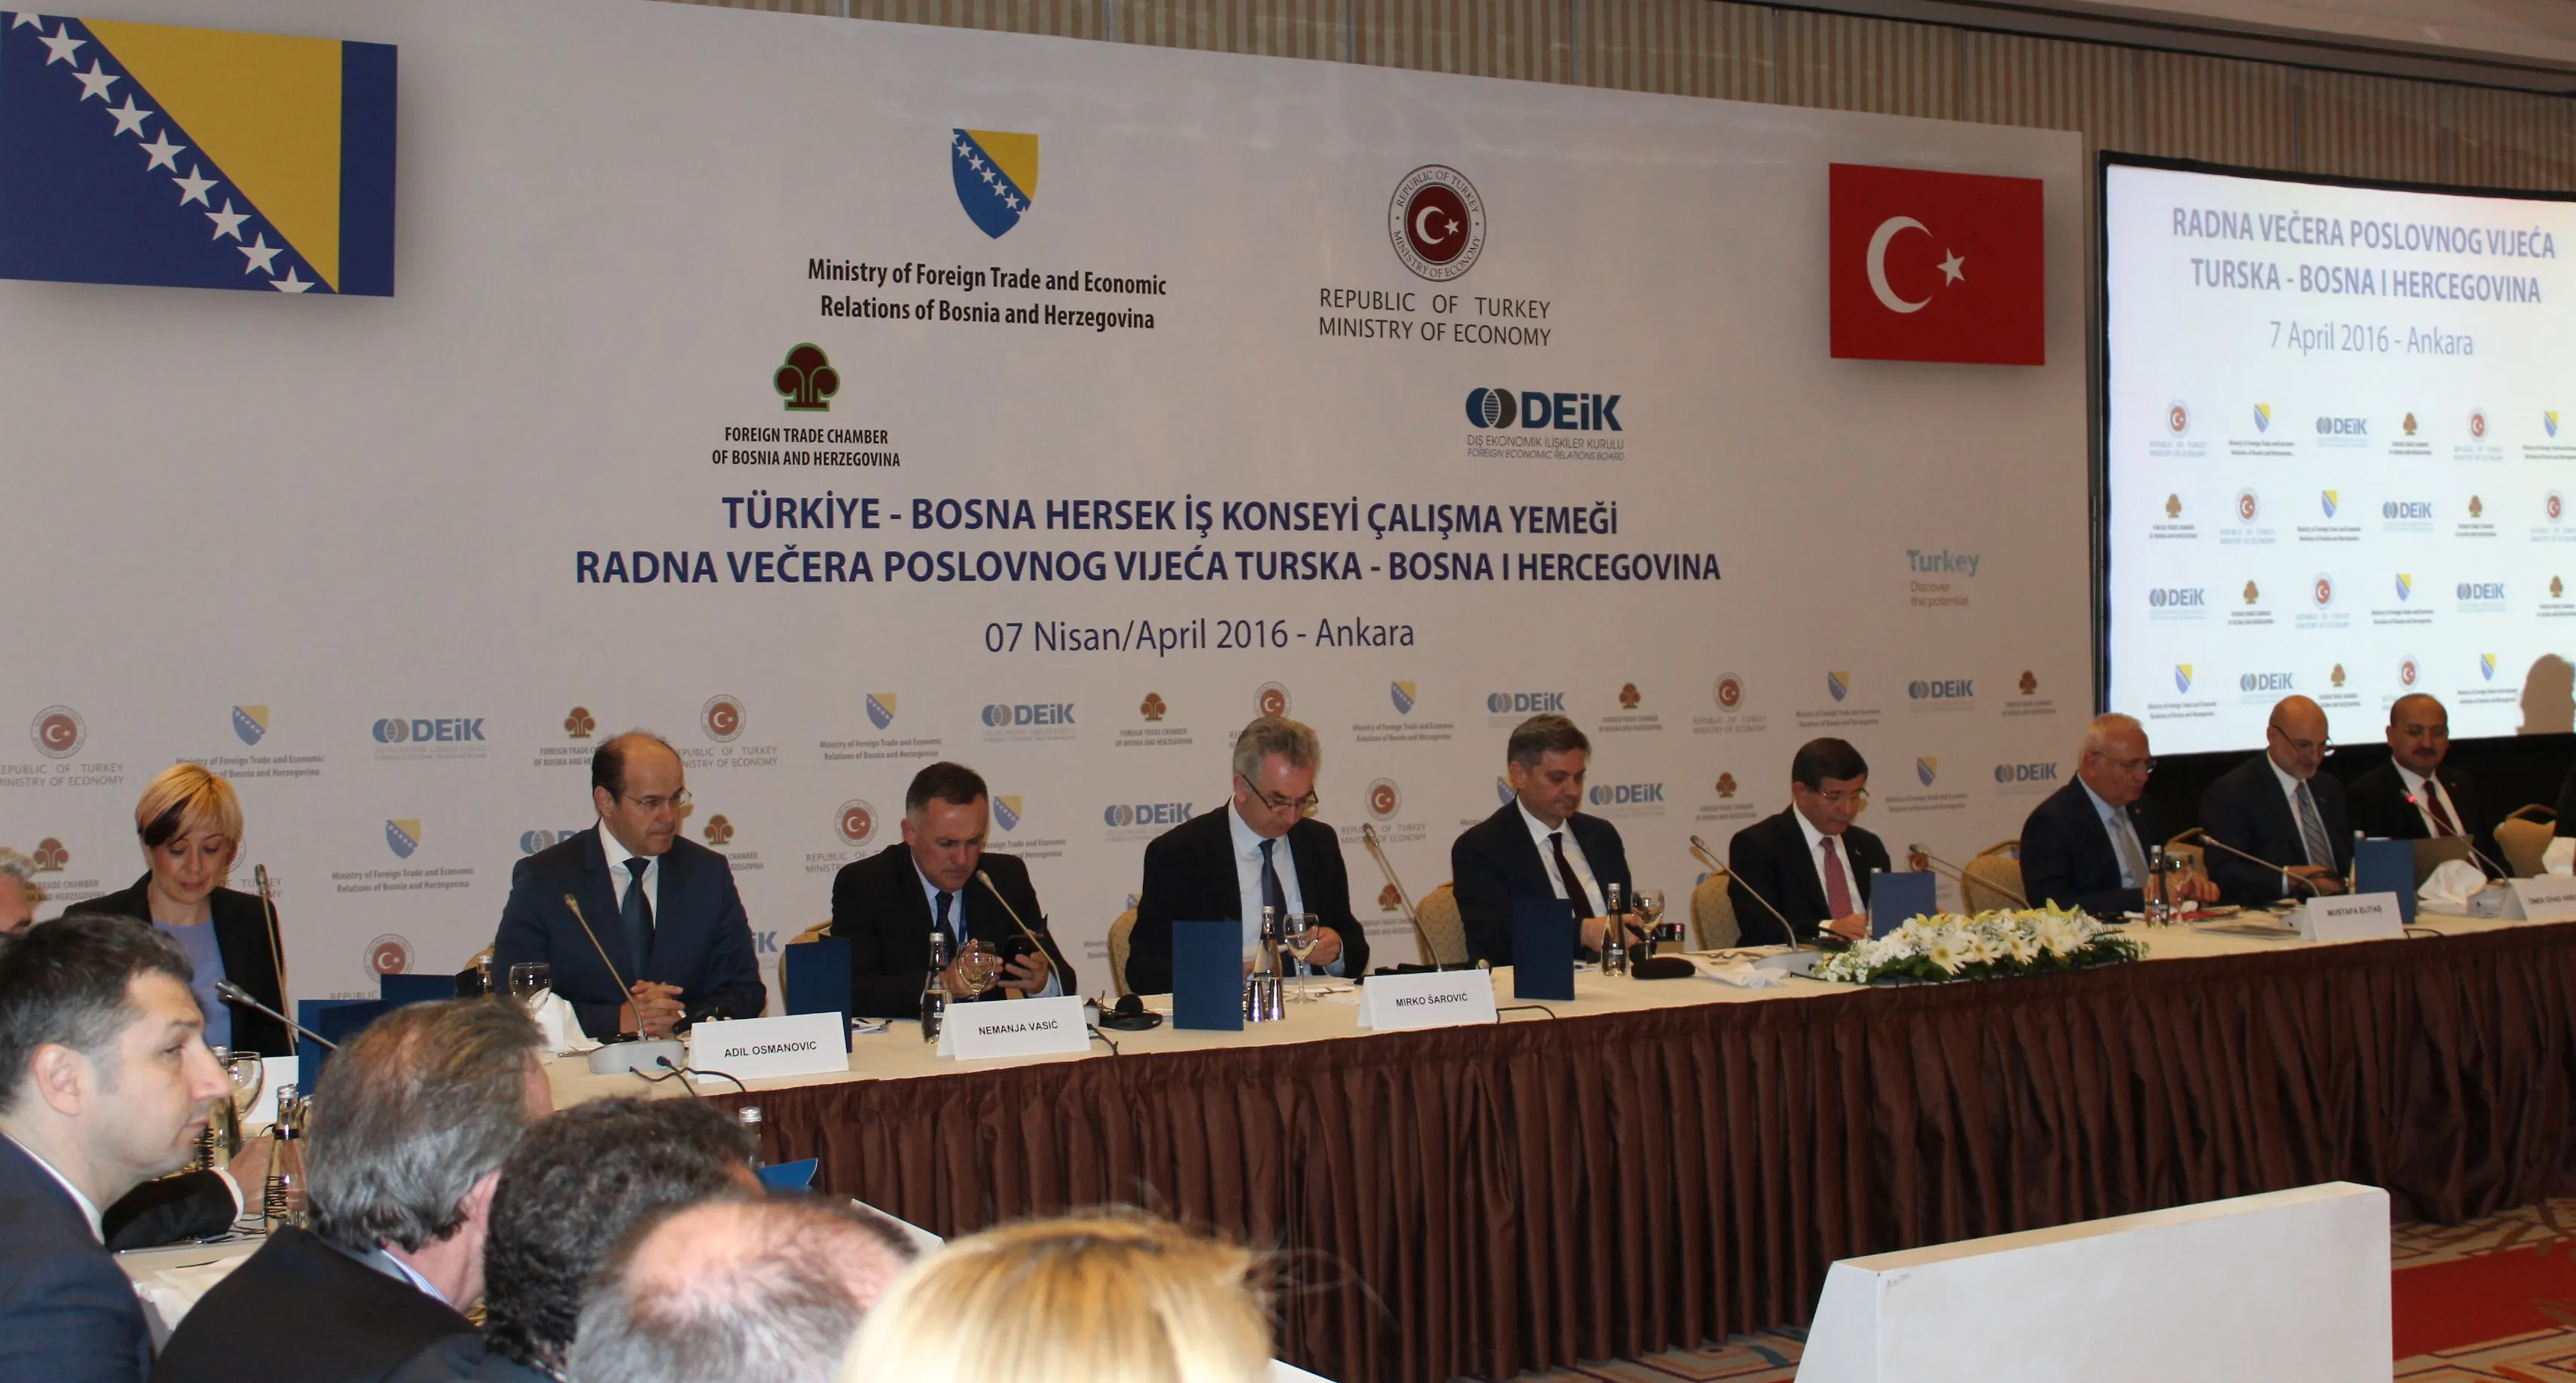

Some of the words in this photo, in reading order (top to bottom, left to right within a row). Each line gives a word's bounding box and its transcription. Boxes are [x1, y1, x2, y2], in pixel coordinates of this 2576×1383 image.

[1397, 171, 1433, 207] REPUBLIC
[1436, 170, 1450, 180] OF
[1451, 175, 1479, 213] TURKEY
[2172, 207, 2254, 240] RADNA
[2259, 210, 2345, 246] VEČERA
[2350, 219, 2482, 255] POSLOVNOG
[2486, 226, 2556, 259] VIJEĆA
[1394, 231, 1429, 274] MINISTRY
[1430, 268, 1443, 277] OF
[1445, 237, 1481, 277] ECONOMY
[808, 259, 888, 287] Ministry
[892, 262, 912, 283] of
[916, 265, 985, 292] Foreign
[991, 267, 1040, 289] Trade
[1045, 270, 1079, 291] and
[1085, 271, 1166, 295] Economic
[2191, 258, 2281, 291] TURSKA
[2299, 265, 2376, 295] BOSNA
[2382, 270, 2386, 296] I
[2393, 271, 2541, 303] HERCEGOVINA
[1319, 288, 1416, 312] REPUBLIC
[1432, 294, 1458, 314] OF
[1474, 297, 1551, 319] TURKEY
[821, 295, 910, 320] Relations
[915, 299, 934, 320] of
[940, 300, 1001, 323] Bosnia
[1004, 304, 1039, 324] and
[1044, 304, 1154, 332] Herzegovina
[1319, 317, 1413, 340] MINISTRY
[1420, 322, 1446, 341] OF
[1453, 323, 1551, 347] ECONOMY
[2270, 321, 2281, 349] 7
[2288, 321, 2335, 356] April
[2341, 324, 2388, 353] 2016
[2407, 326, 2474, 356] Ankara
[725, 427, 780, 442] FOREIGN
[783, 428, 824, 443] TRADE
[827, 429, 888, 444] CHAMBER
[1468, 434, 1484, 448] DIŞ
[1487, 435, 1542, 448] EKONOMİK
[1587, 439, 1624, 449] KURULU
[712, 450, 728, 464] OF
[732, 451, 780, 465] BOSNIA
[783, 451, 810, 465] AND
[814, 452, 900, 467] HERZEGOVINA
[1468, 448, 1504, 458] FOREIGN
[1506, 450, 1551, 460] ECONOMIC
[1554, 451, 1595, 460] RELATIONS
[722, 488, 880, 528] TÜRKİYE
[912, 499, 1037, 530] BOSNA
[1046, 500, 1175, 530] HERSEK
[1185, 494, 1213, 537] İŞ
[1222, 496, 1358, 531] KONSEYİ
[1367, 503, 1502, 539] ÇALIŞMA
[1510, 501, 1618, 534] YEMEĞİ
[576, 551, 718, 583] RADNA
[727, 544, 874, 583] VEČERA
[885, 551, 1107, 583] POSLOVNOG
[1115, 545, 1228, 584] VIJEĆA
[1235, 551, 1363, 580] TURSKA
[1389, 552, 1495, 580] BOSNA
[1502, 552, 1509, 580] I
[1518, 552, 1722, 581] HERCEGOVINA
[1906, 549, 1980, 578] Turkey
[1911, 581, 1950, 592] Discover
[1911, 596, 1925, 606] the
[1929, 596, 1969, 608] potential
[985, 623, 1023, 653] 07
[1034, 620, 1207, 657] Nisan/April
[1215, 620, 1288, 649] 2016
[1315, 617, 1415, 647] Ankara
[721, 747, 735, 756] OF
[741, 746, 778, 755] TURKEY
[57, 764, 71, 773] OF
[81, 763, 123, 773] TURKEY
[717, 759, 731, 767] OF
[732, 757, 778, 766] ECONOMY
[50, 777, 66, 786] OF
[69, 776, 124, 786] ECONOMY
[806, 852, 848, 862] REPUBLIC
[2327, 907, 2358, 916] MUSTAFA
[1396, 996, 1426, 1007] MIRKO
[978, 1022, 1026, 1036] NEMANJA
[1028, 1019, 1058, 1031] VASIĆ
[724, 1045, 749, 1057] ADIL
